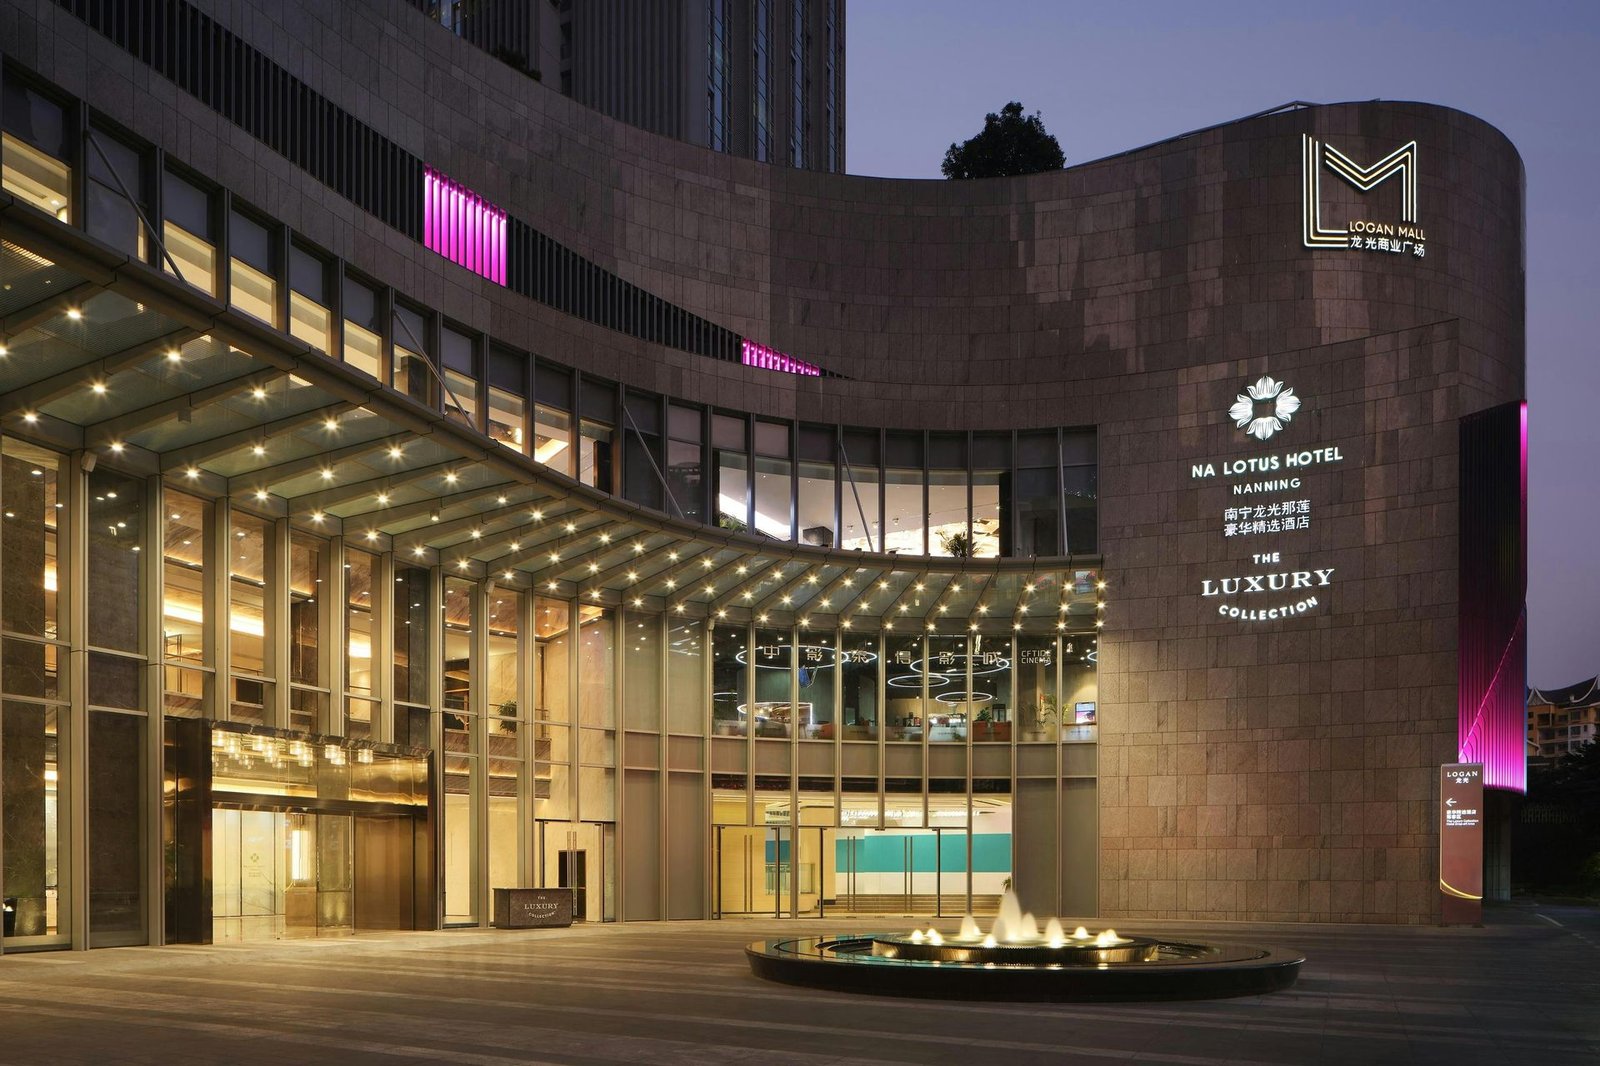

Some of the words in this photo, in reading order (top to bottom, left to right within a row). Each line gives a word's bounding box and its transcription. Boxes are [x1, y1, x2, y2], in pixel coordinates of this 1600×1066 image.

[1349, 220, 1394, 236] LOGAN
[1398, 226, 1426, 241] MALL
[1350, 235, 1425, 258] 龙光商业广场
[1191, 463, 1216, 478] NA
[1223, 455, 1280, 476] LOTUS
[1286, 446, 1344, 468] HOTEL
[1233, 477, 1301, 495] NANNING
[1224, 499, 1311, 522] 南宁龙光那莲
[1223, 515, 1310, 537] 豪华精选酒店
[1252, 552, 1281, 565] THE
[1201, 568, 1335, 597] LUXURY
[1218, 596, 1319, 620] COLLECTION
